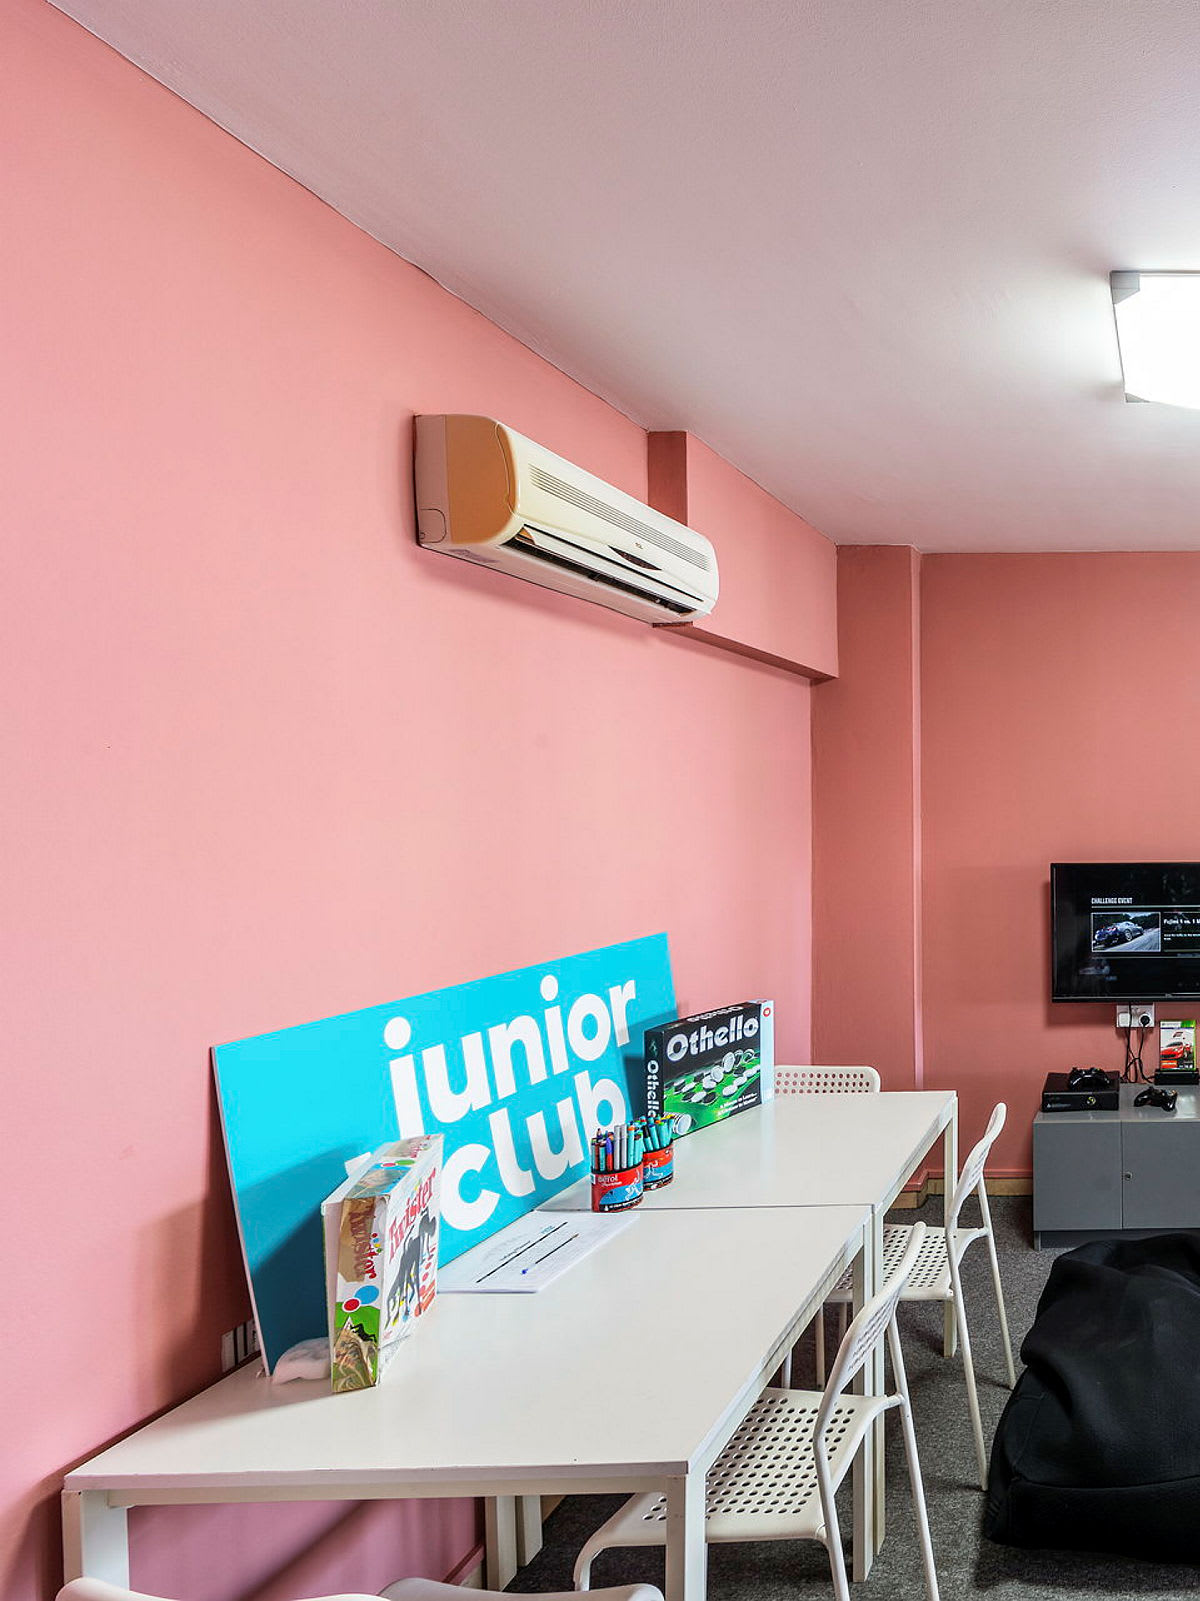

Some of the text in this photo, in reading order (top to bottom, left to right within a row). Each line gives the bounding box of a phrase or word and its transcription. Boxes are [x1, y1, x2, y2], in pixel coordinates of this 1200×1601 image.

[345, 975, 636, 1177] junior
[667, 1015, 759, 1062] Othello
[438, 1070, 626, 1231] club
[389, 1167, 436, 1264] Twister
